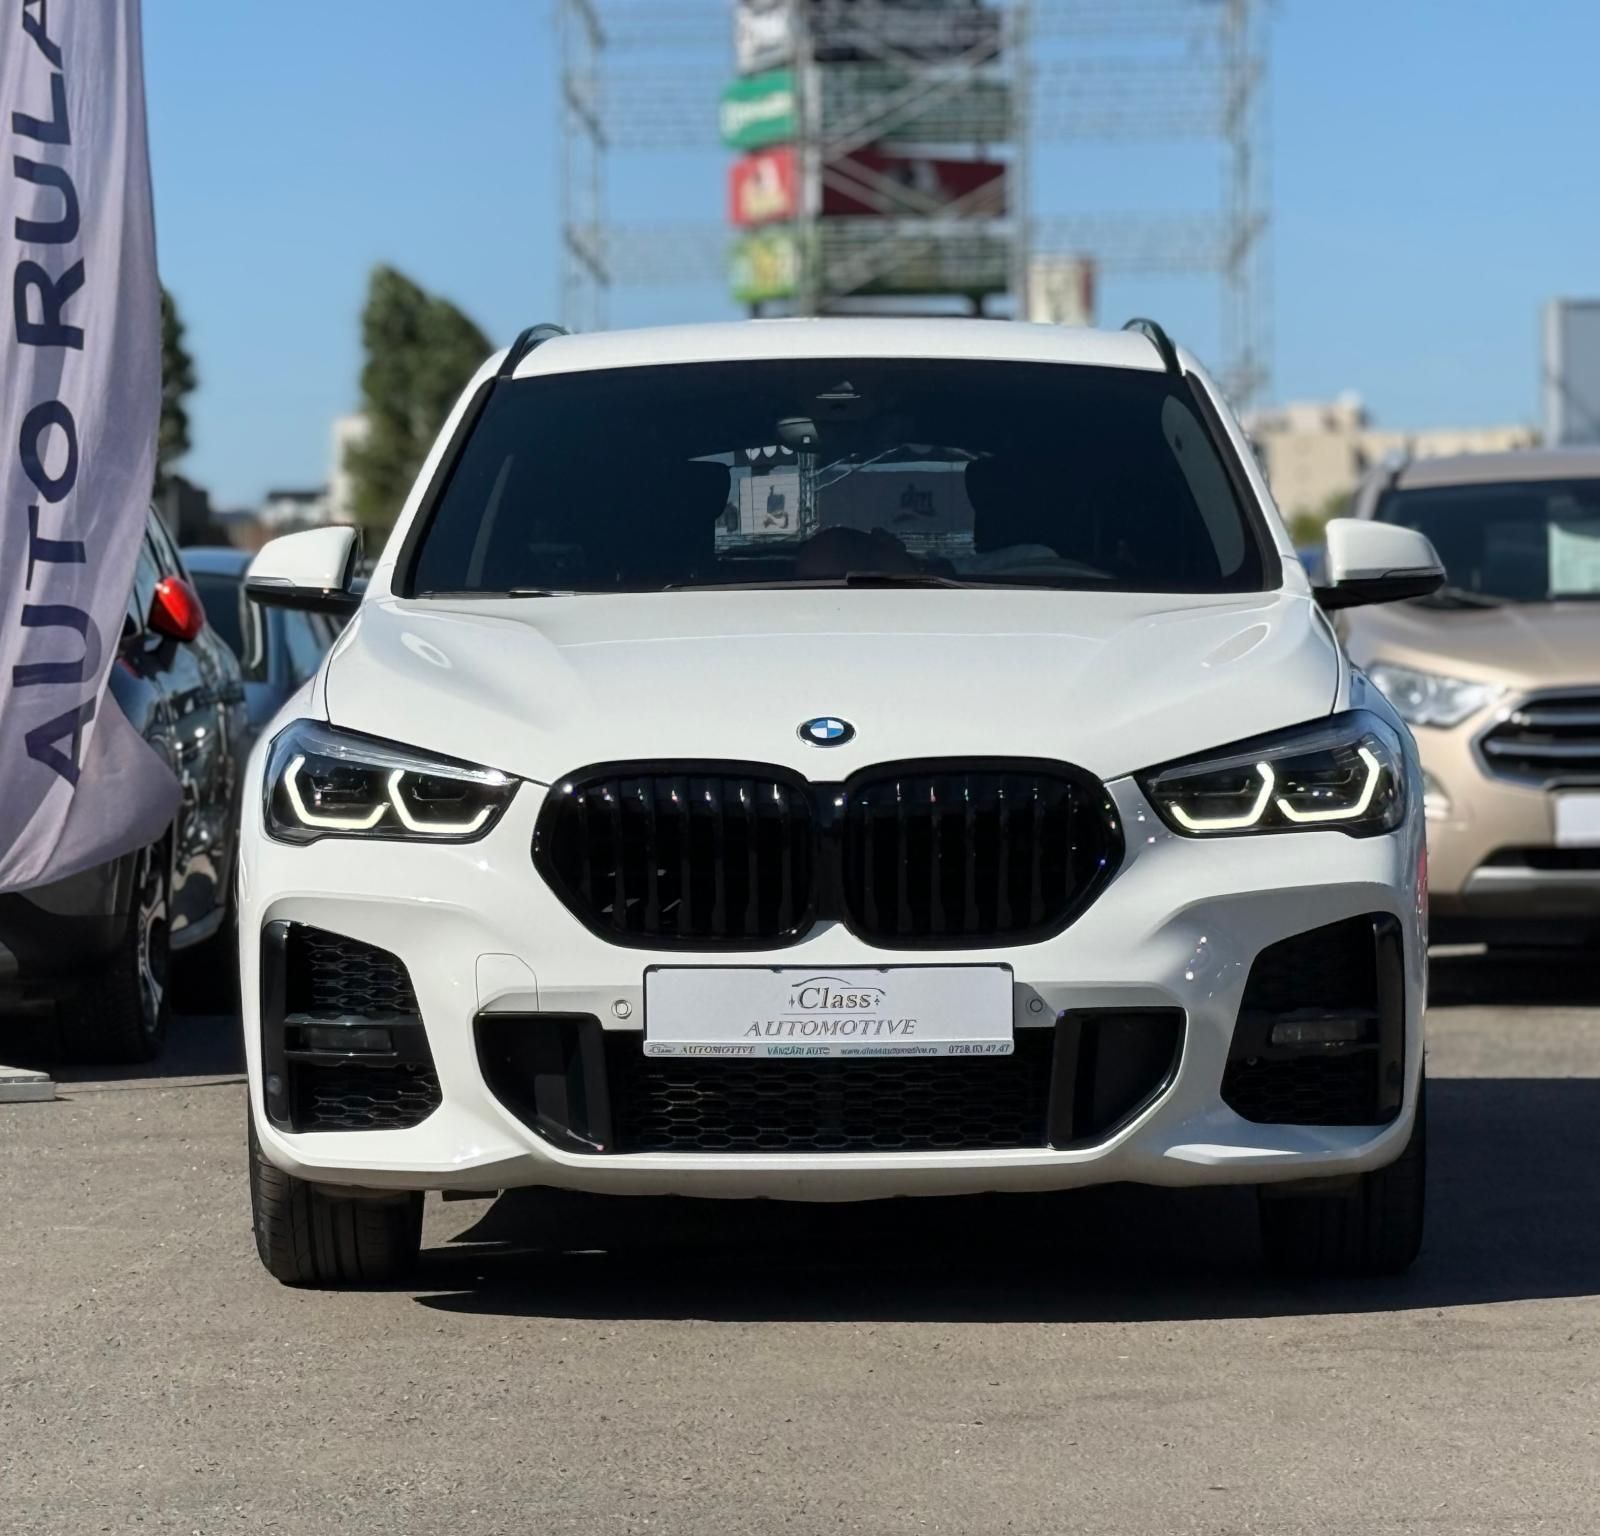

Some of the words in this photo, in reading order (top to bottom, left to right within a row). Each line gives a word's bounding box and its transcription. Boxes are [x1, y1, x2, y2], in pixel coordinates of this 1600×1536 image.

[13, 399, 102, 787] AUTO
[798, 987, 871, 1009] Class
[743, 1019, 917, 1037] AUTOMOTIVE
[681, 1045, 756, 1055] AUTOMOTIVE
